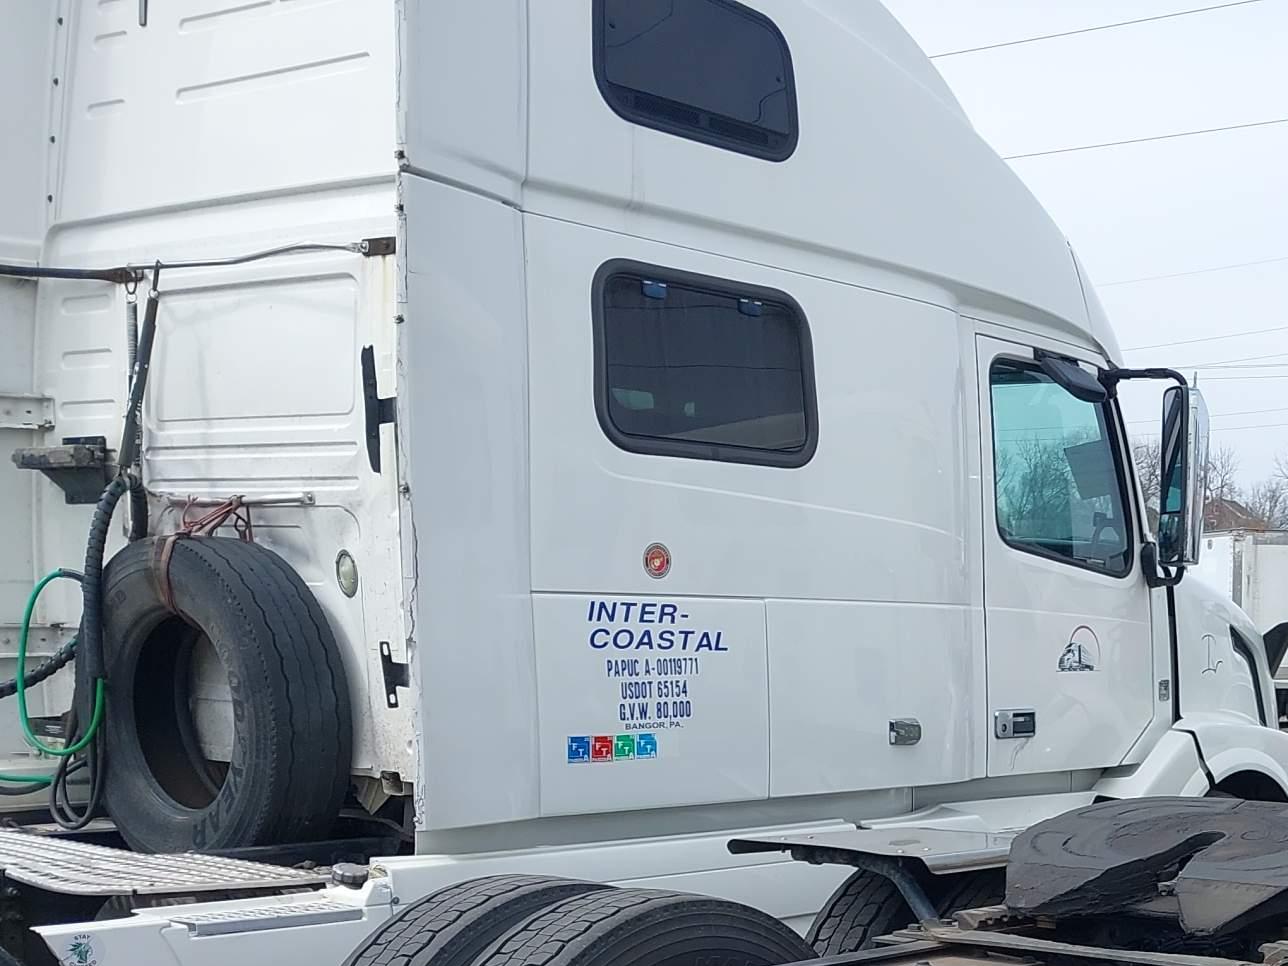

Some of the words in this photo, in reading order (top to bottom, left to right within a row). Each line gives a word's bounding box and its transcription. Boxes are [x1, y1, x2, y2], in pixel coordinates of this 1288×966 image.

[587, 600, 689, 624] INTER-
[589, 628, 728, 652] COASTAL
[606, 658, 640, 677] PAPUC
[644, 656, 699, 676] A-00119771
[620, 680, 653, 700] USDOT
[657, 679, 688, 698] 65154
[619, 702, 652, 721] G.V.W.
[656, 700, 691, 721] 80,000
